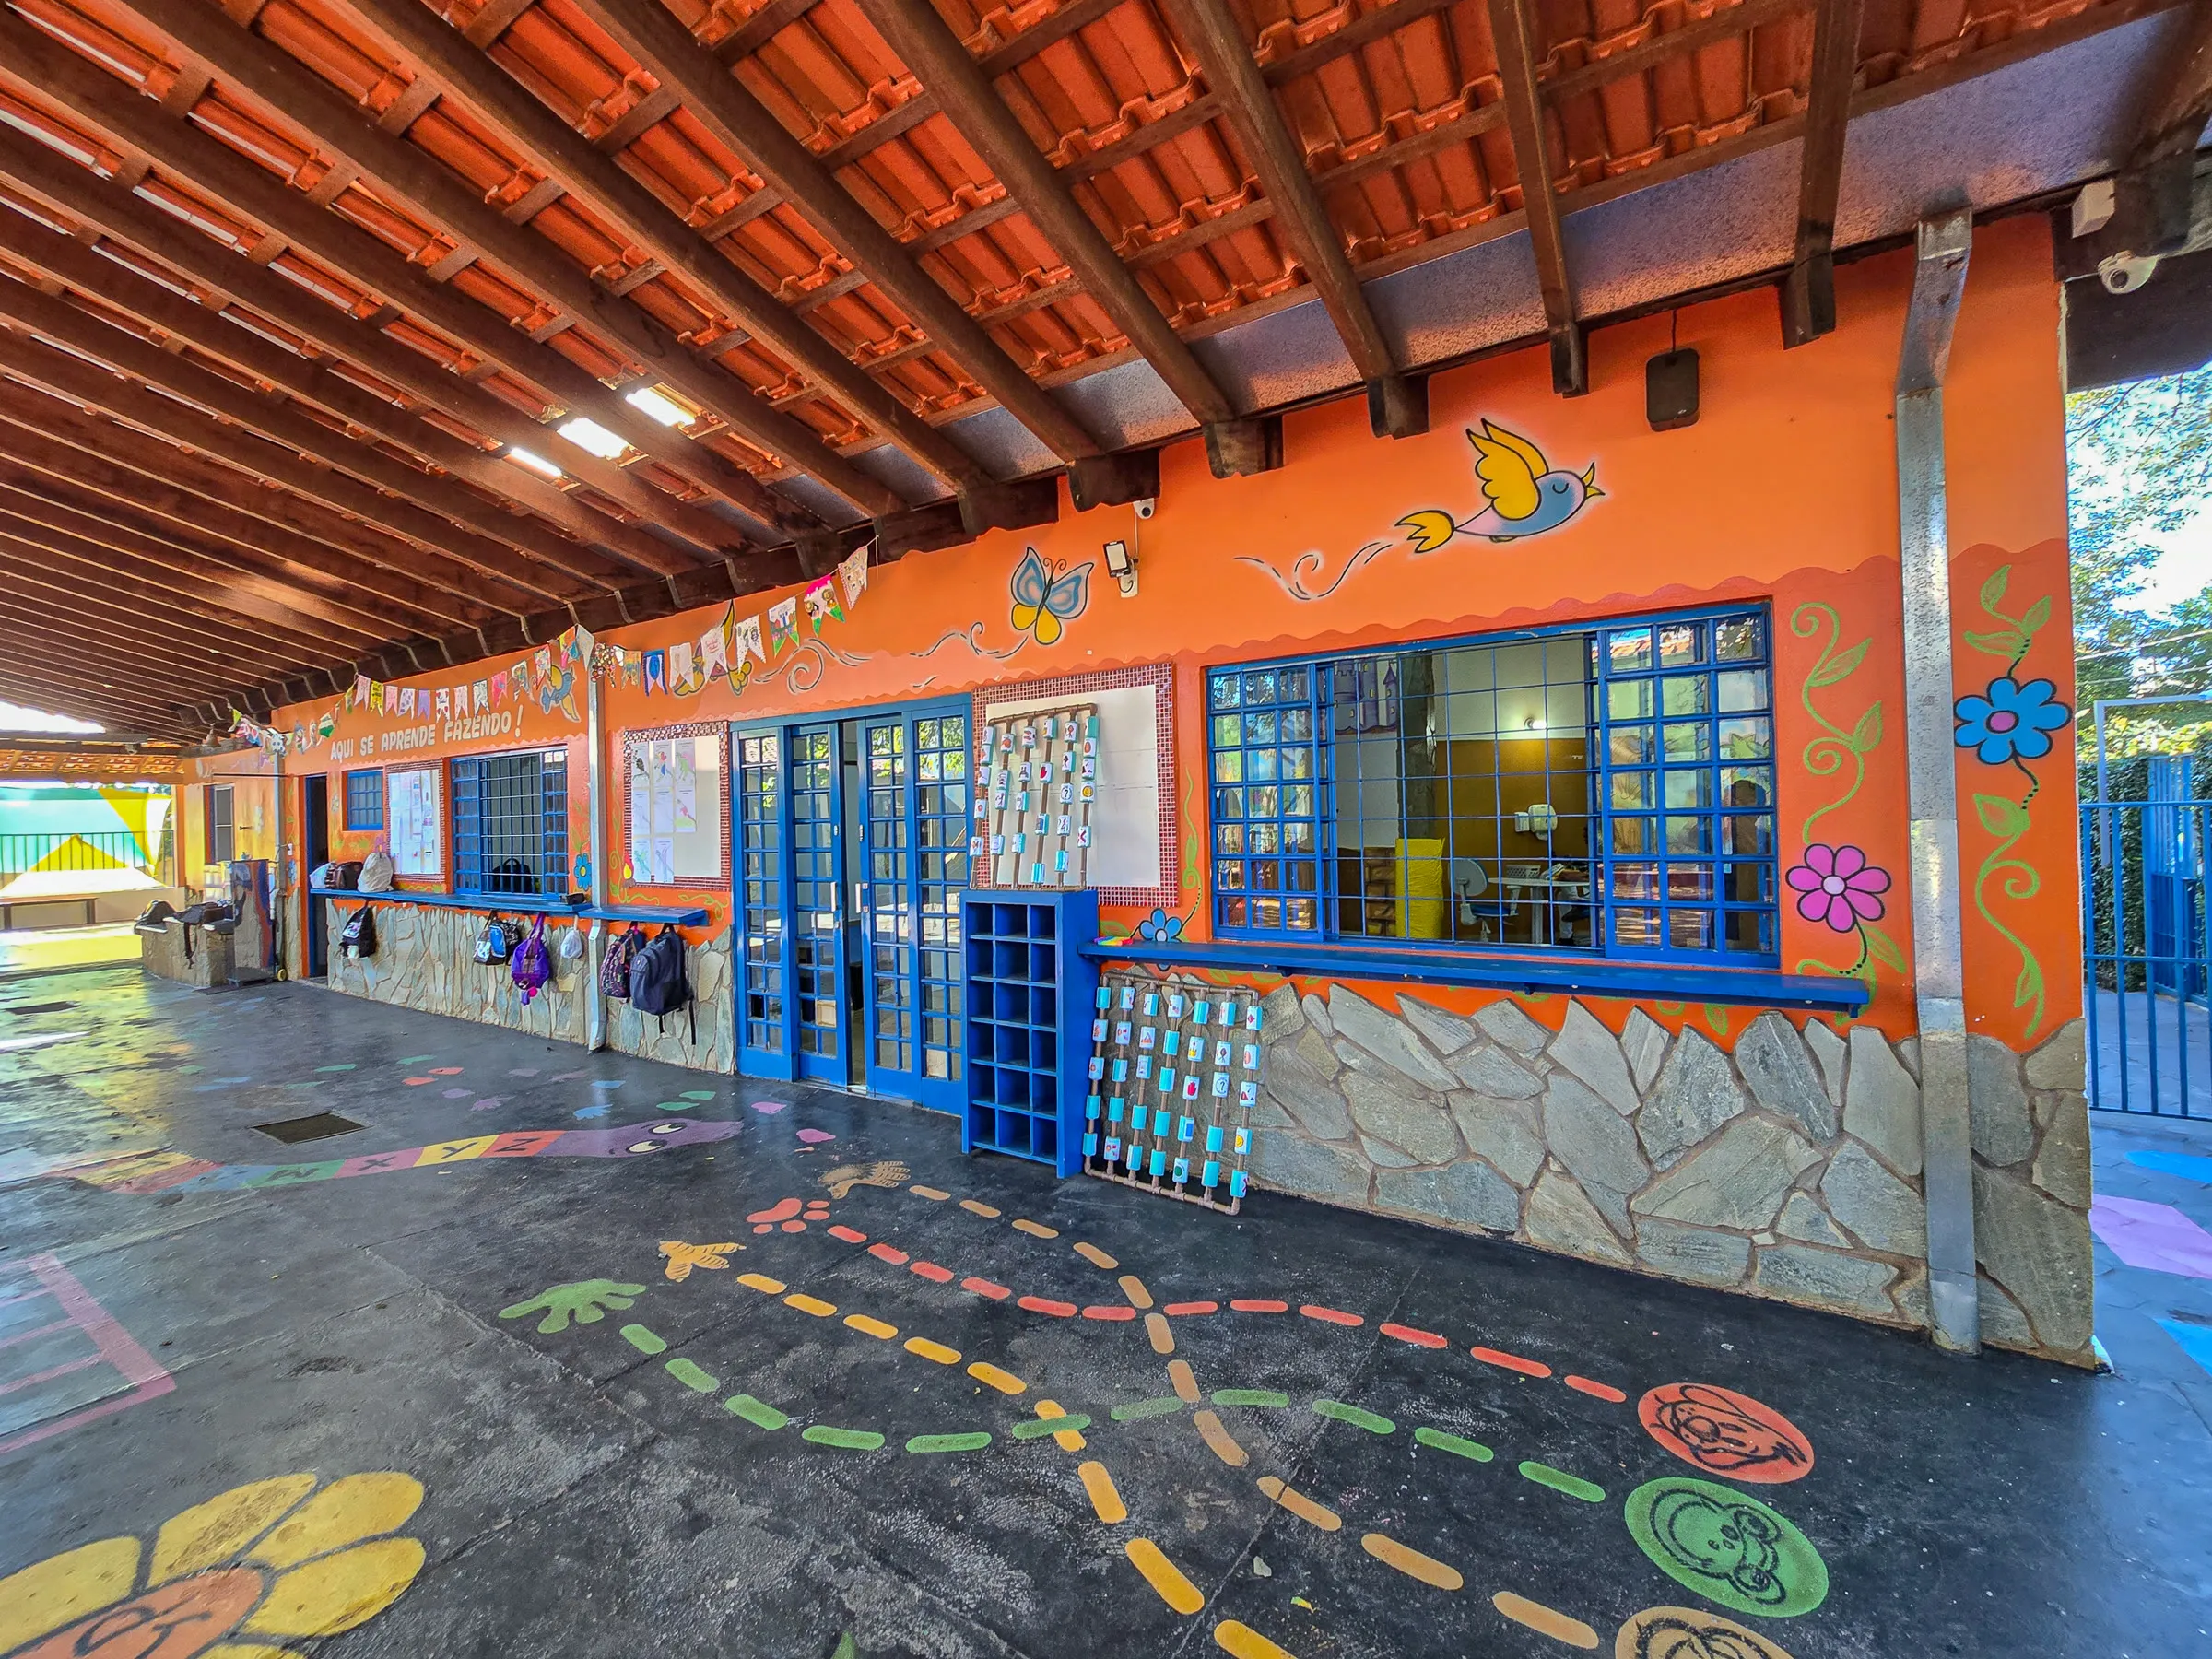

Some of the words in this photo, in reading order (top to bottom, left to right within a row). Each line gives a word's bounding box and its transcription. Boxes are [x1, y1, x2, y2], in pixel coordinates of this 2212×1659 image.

[330, 738, 354, 763] AQUI
[359, 735, 374, 756] SE
[381, 724, 436, 752] APRENDE
[444, 711, 512, 743] FAZENDO
[515, 704, 524, 738] !
[357, 1156, 397, 1172] X
[494, 1137, 542, 1152] Z
